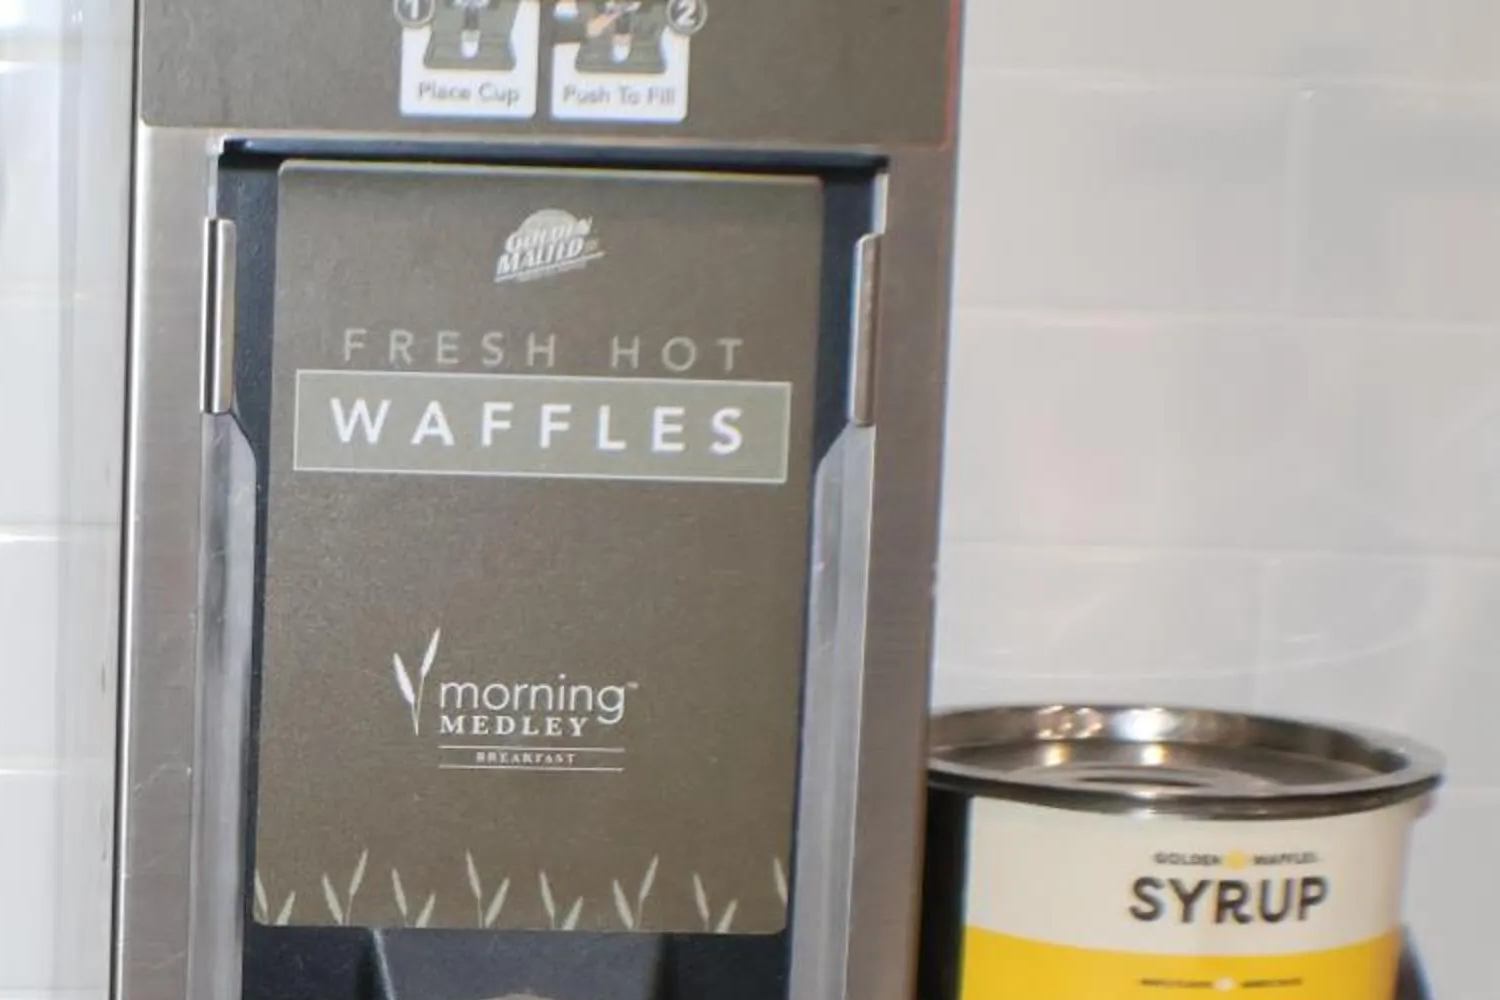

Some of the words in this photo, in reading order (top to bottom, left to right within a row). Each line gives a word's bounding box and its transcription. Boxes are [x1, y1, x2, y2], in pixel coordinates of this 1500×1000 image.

[675, 0, 697, 25] 2
[418, 81, 470, 100] Place
[478, 82, 520, 106] Cup
[563, 84, 611, 103] Push
[618, 86, 641, 104] To
[649, 86, 675, 105] Fill
[343, 328, 557, 369] FRESH
[611, 335, 743, 373] HOT
[330, 397, 744, 456] WAFFLES
[440, 673, 625, 724] morning
[439, 714, 589, 737] MEDLEY
[476, 751, 575, 765] BREAKFAST
[1128, 875, 1328, 924] SYRUP
